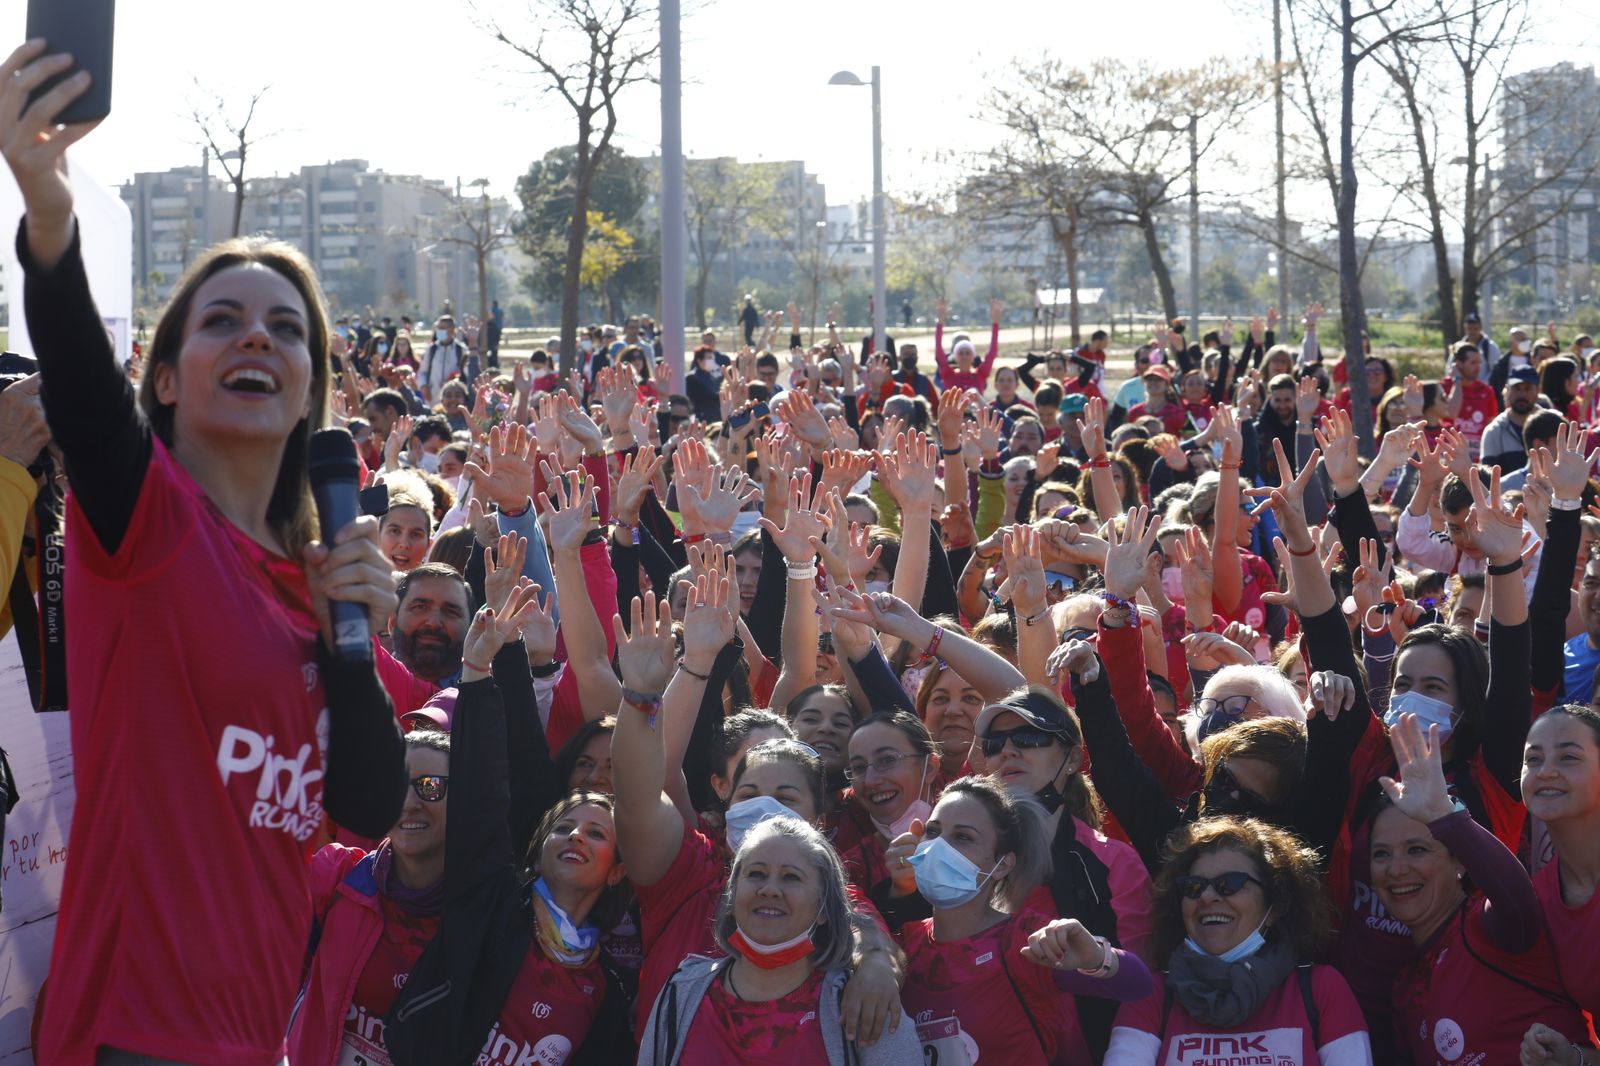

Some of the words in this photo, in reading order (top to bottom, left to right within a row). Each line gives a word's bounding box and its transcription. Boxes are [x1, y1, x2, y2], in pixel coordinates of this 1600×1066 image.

[46, 580, 61, 602] 6D
[47, 607, 58, 636] Mark
[217, 725, 323, 816] Pink
[9, 832, 40, 863] por
[19, 857, 40, 874] tu
[1177, 1035, 1268, 1062] PINK
